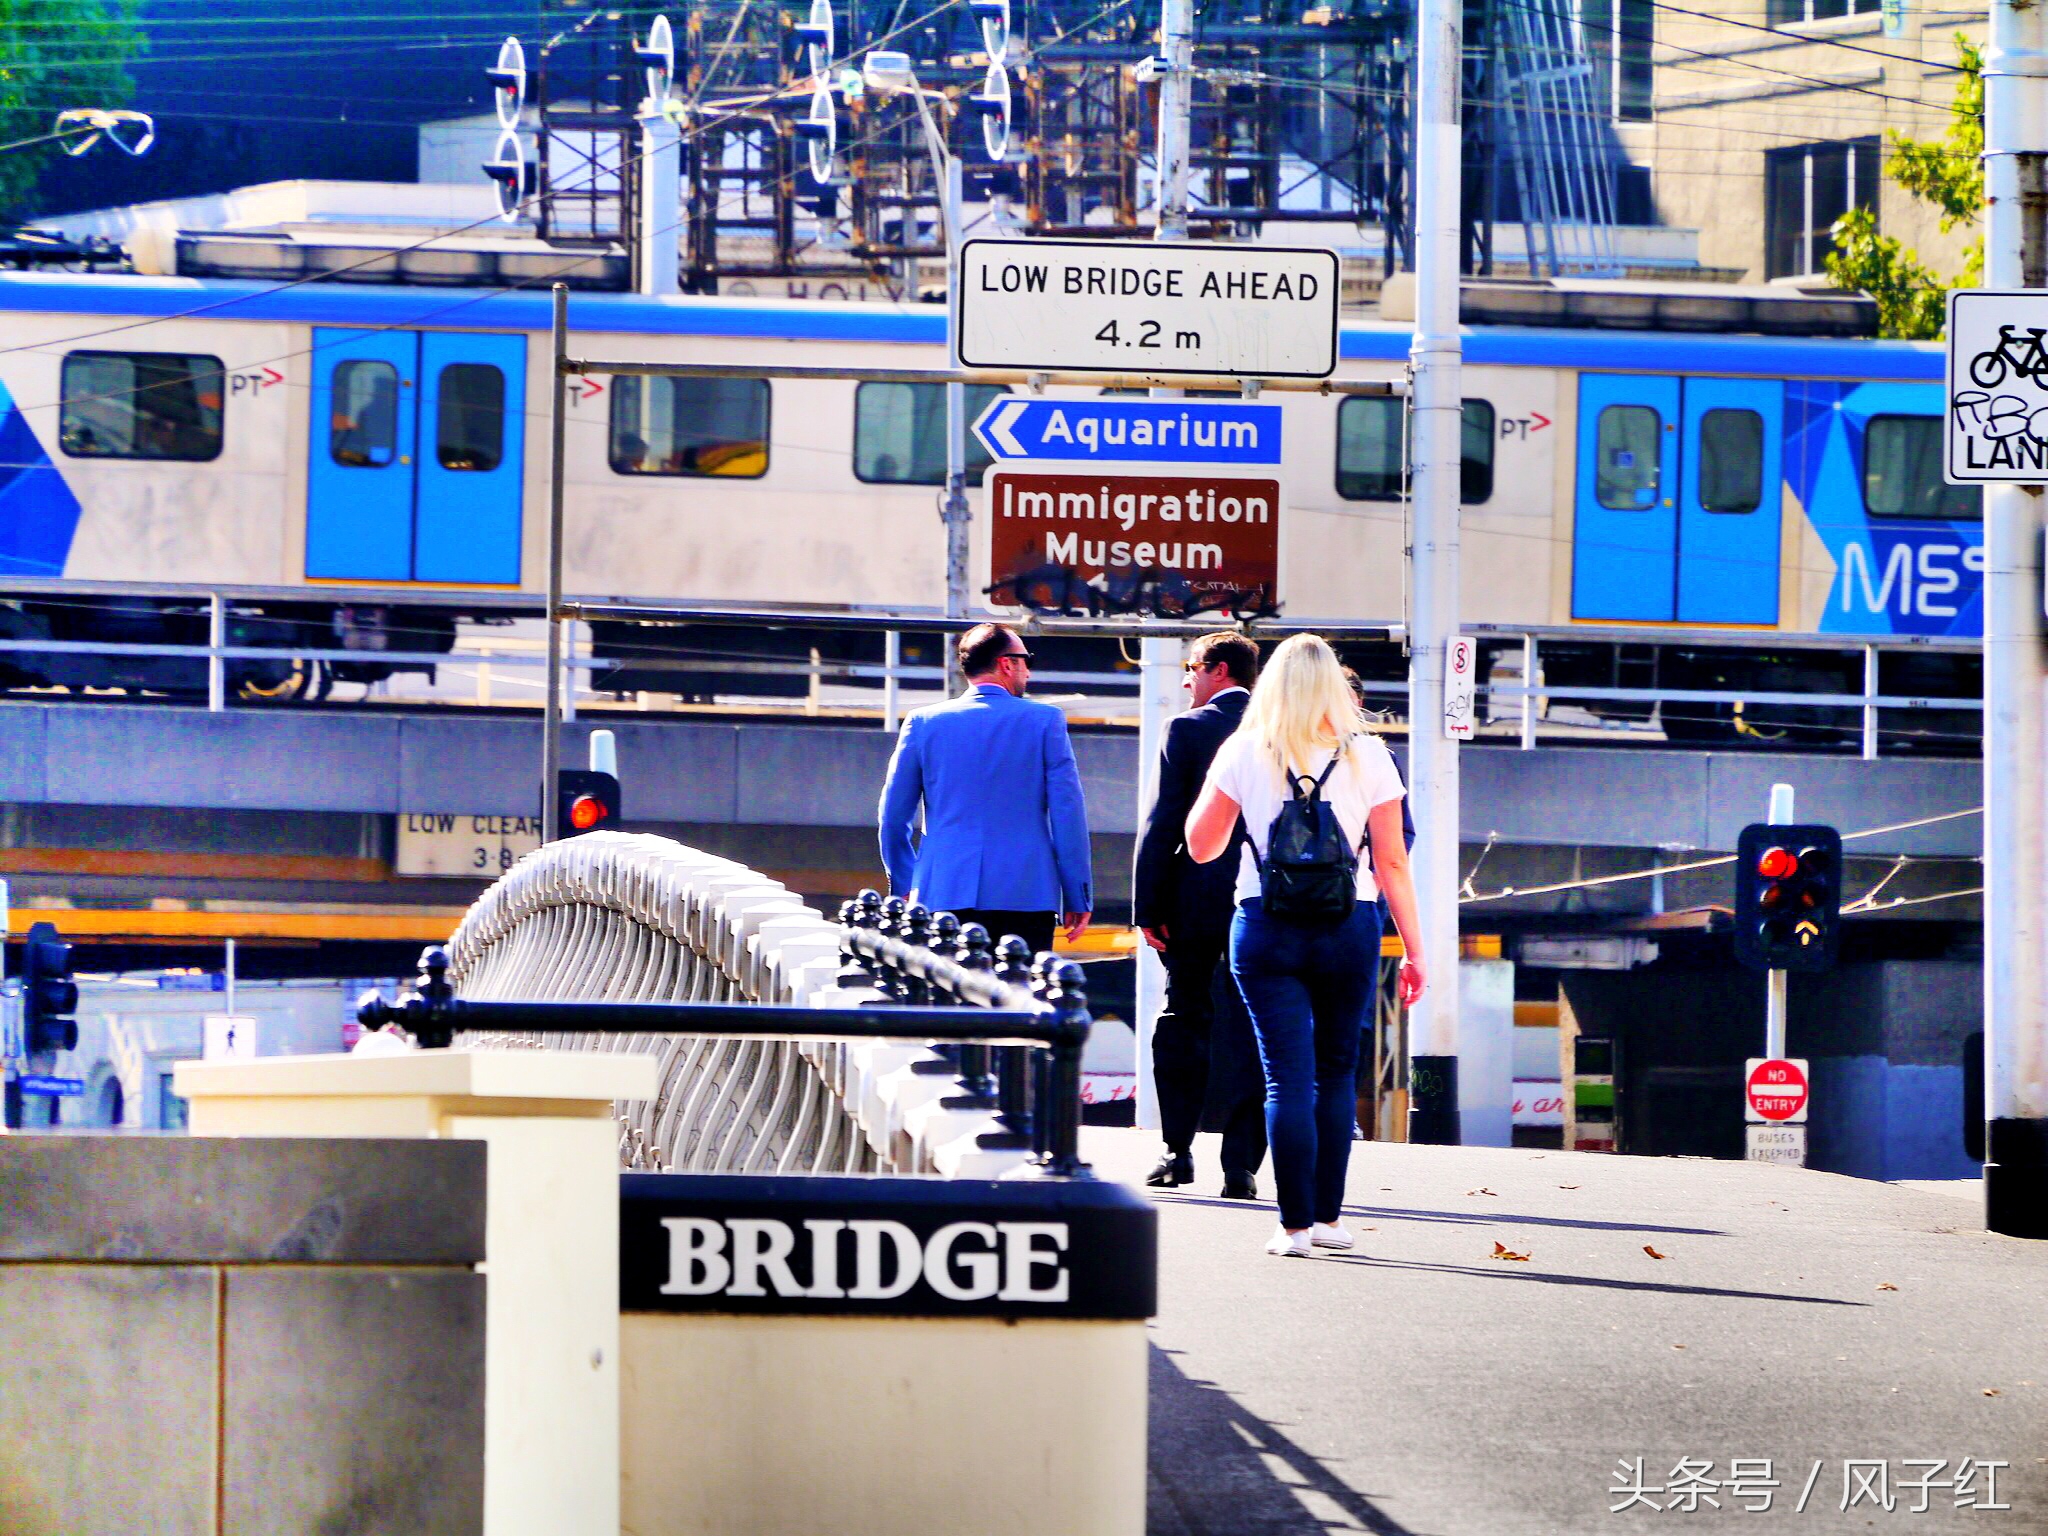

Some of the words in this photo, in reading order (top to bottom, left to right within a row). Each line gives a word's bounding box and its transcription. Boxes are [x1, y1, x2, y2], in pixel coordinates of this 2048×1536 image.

[982, 264, 1048, 293] LOW
[1064, 266, 1183, 297] BRIDGE
[1200, 271, 1318, 301] AHEAD
[1095, 319, 1161, 348] 4.2
[1175, 331, 1201, 349] m
[1041, 409, 1259, 453] Aquarium
[1966, 435, 2048, 470] LAN
[1003, 483, 1269, 531] Immigration
[1046, 531, 1223, 570] Museum
[408, 813, 456, 833] LOW
[1767, 1069, 1787, 1082] NO
[1755, 1098, 1798, 1111] ENTRY
[1758, 1133, 1795, 1144] BUSES
[660, 1217, 1069, 1302] BRIDGE
